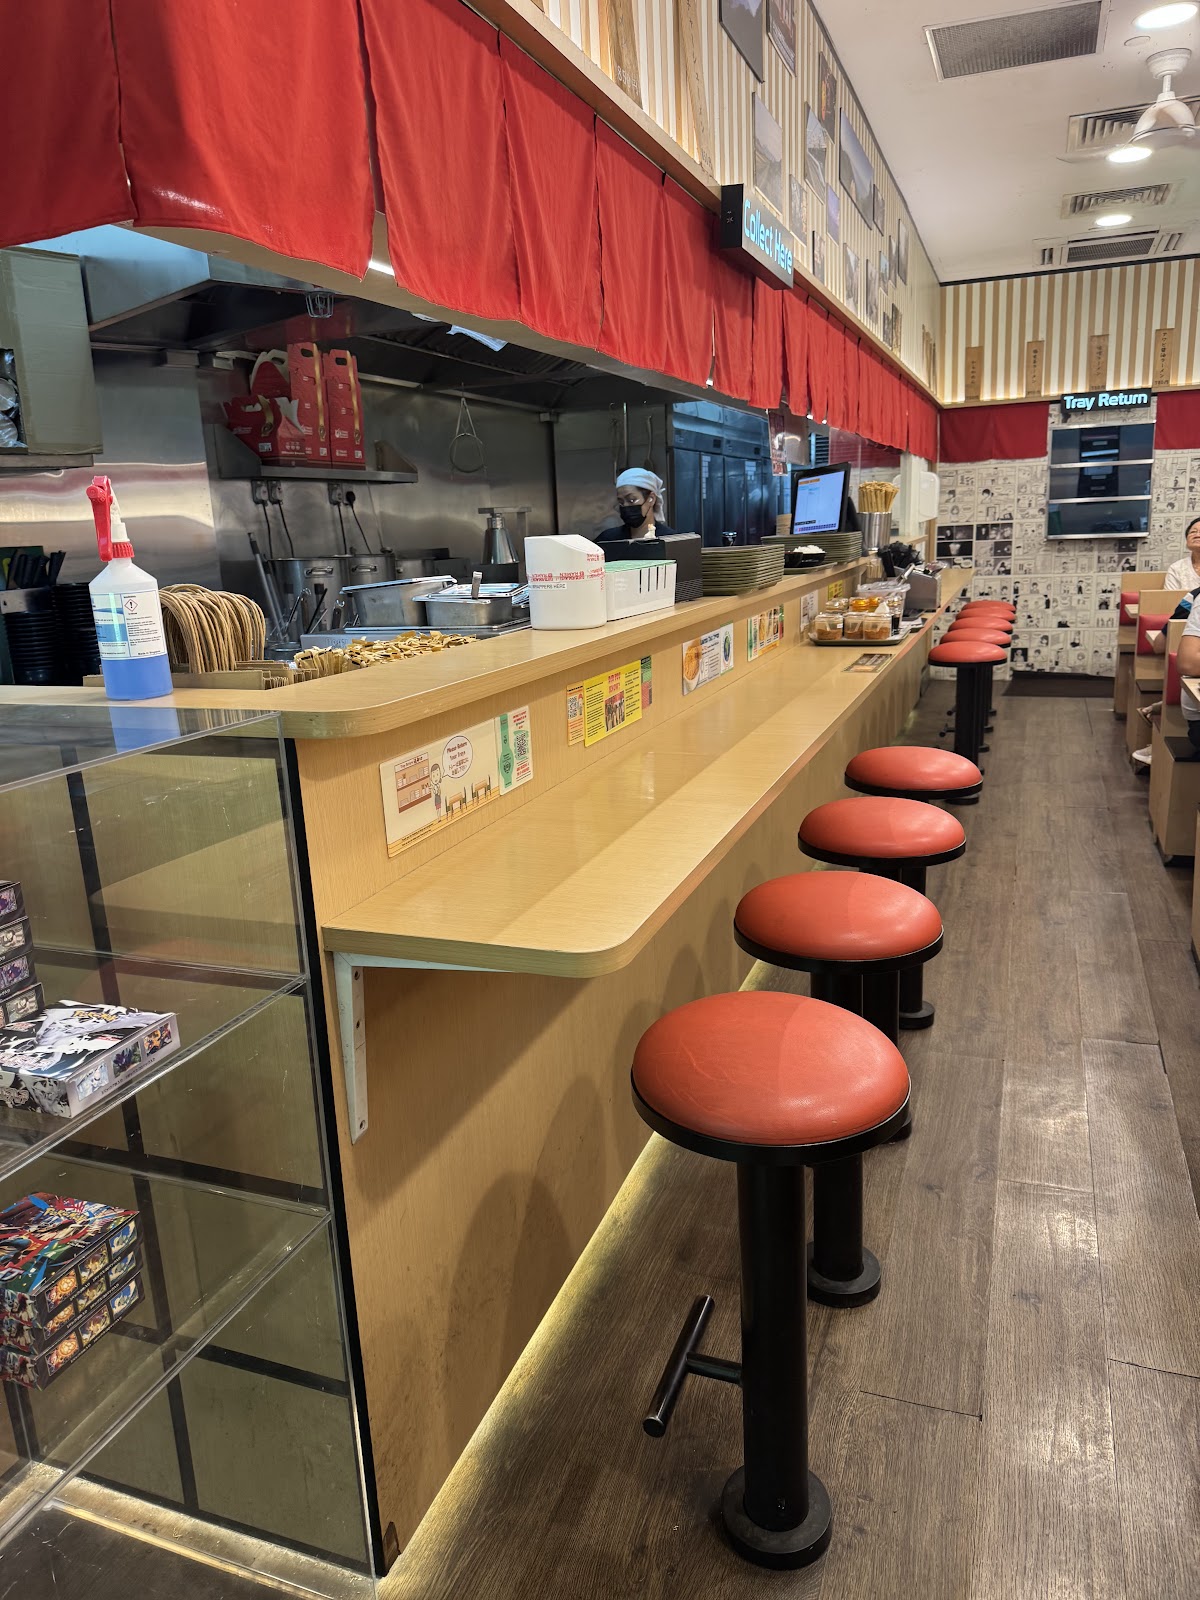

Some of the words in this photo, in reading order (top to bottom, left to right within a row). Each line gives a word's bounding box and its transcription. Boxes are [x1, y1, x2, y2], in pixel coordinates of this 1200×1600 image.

[744, 199, 773, 258] Collect
[774, 228, 793, 275] Here
[1063, 395, 1095, 411] Tray
[1098, 393, 1148, 407] Return
